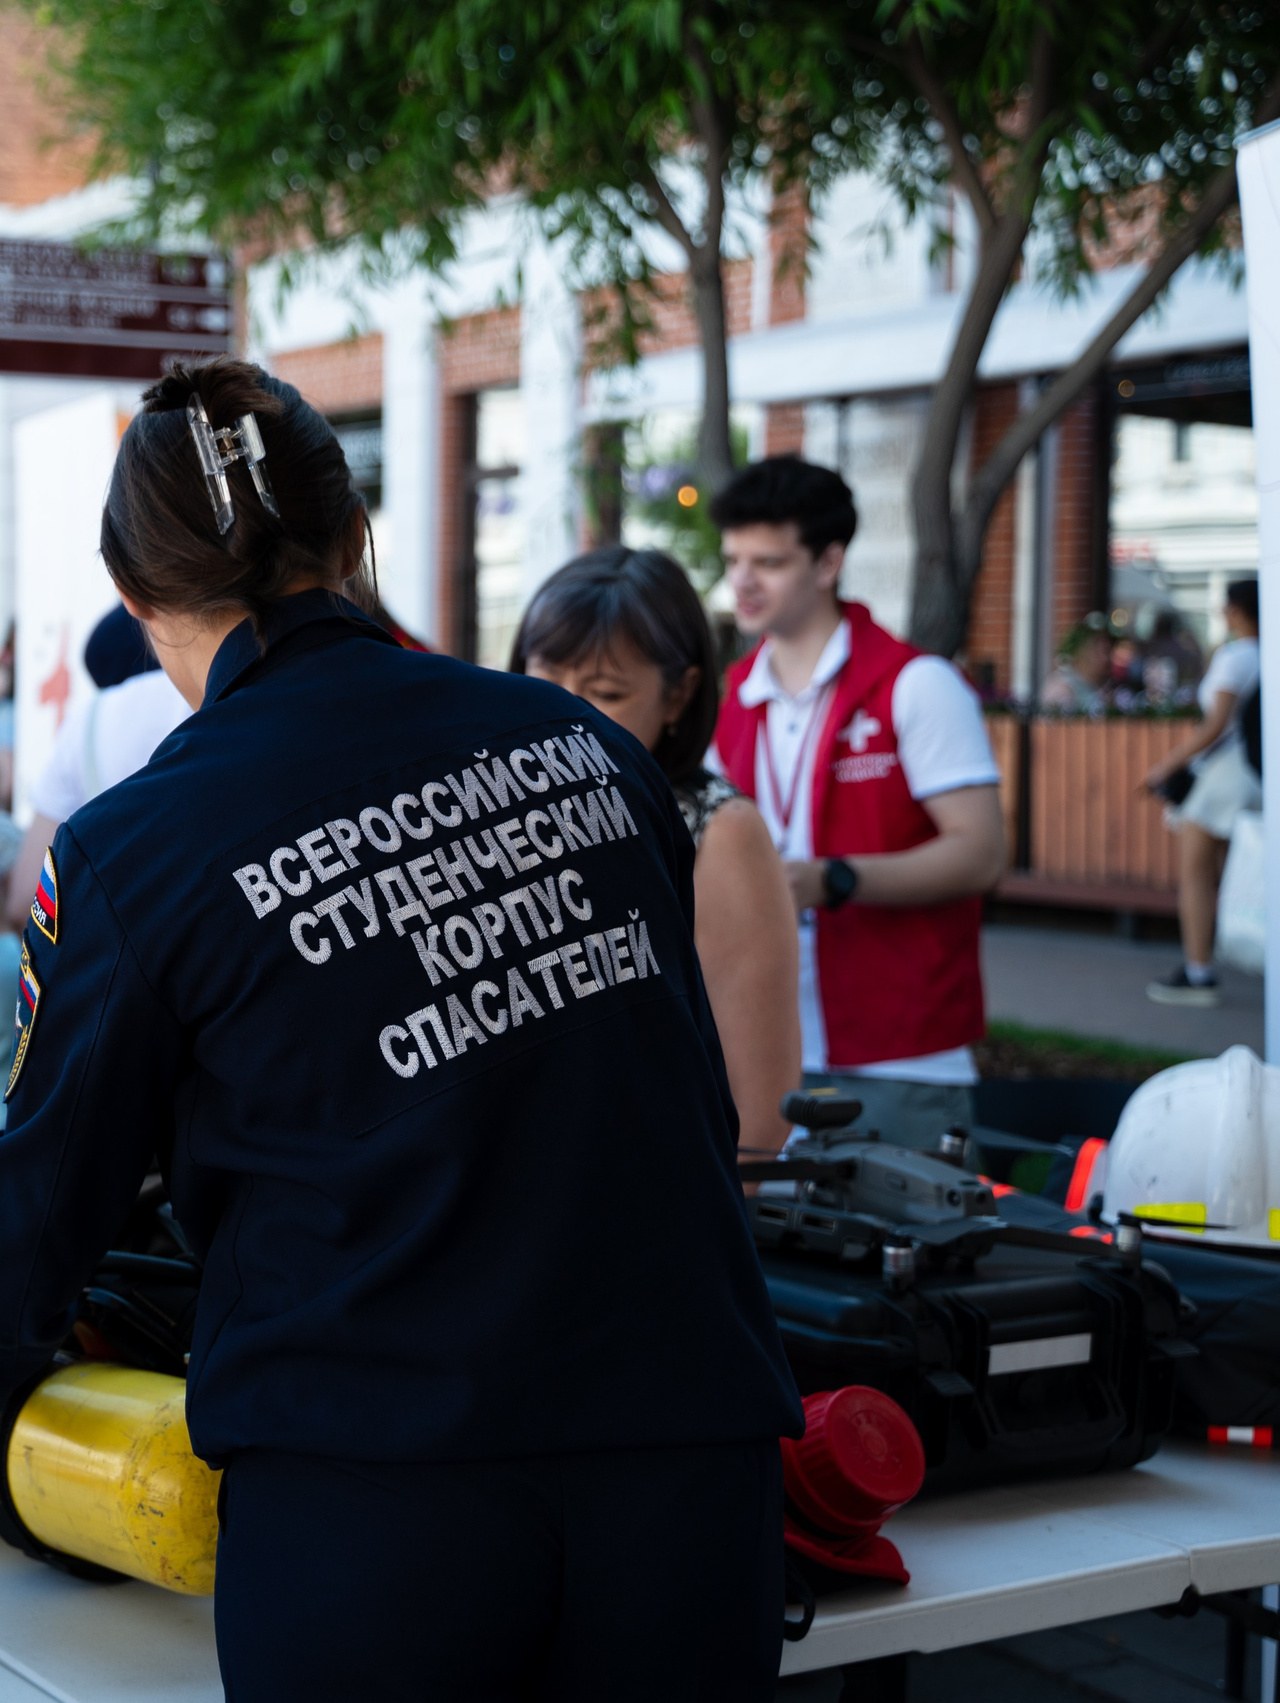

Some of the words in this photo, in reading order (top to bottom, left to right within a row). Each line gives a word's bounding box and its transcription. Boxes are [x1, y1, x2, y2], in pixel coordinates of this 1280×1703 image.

[232, 724, 620, 919] ВСЕРОССИЙСКИЙ
[289, 775, 639, 965] СТУДЕНЧЕСКИЙ
[378, 907, 661, 1078] СПАСАТЕЛЕЙ
[410, 868, 593, 987] КОРПУС
